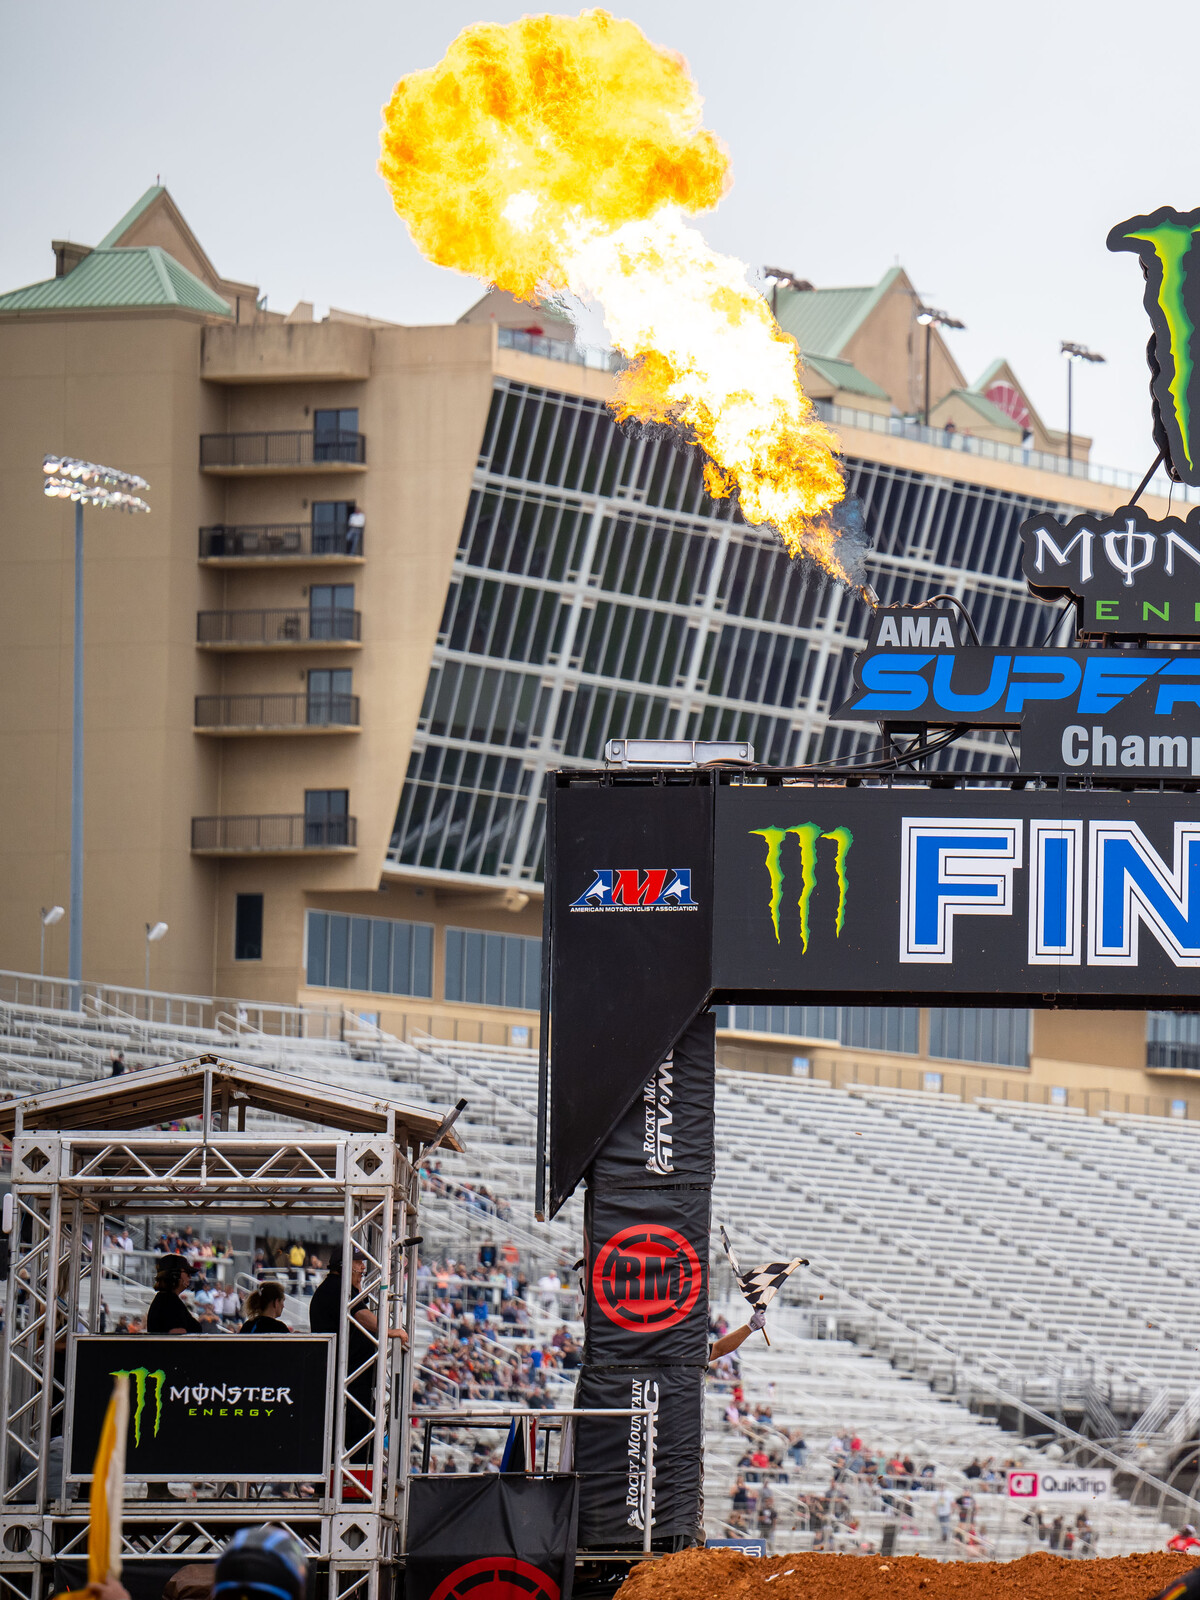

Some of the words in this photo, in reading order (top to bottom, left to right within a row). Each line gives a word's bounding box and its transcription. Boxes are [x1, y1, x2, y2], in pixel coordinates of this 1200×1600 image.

[876, 616, 955, 648] AMA
[569, 868, 700, 906] AMA
[643, 1106, 656, 1154] ROCKY
[615, 1255, 681, 1301] RM
[169, 1382, 294, 1405] MONSTER
[188, 1408, 274, 1417] ENERGY
[1041, 1475, 1107, 1494] QuikTrip
